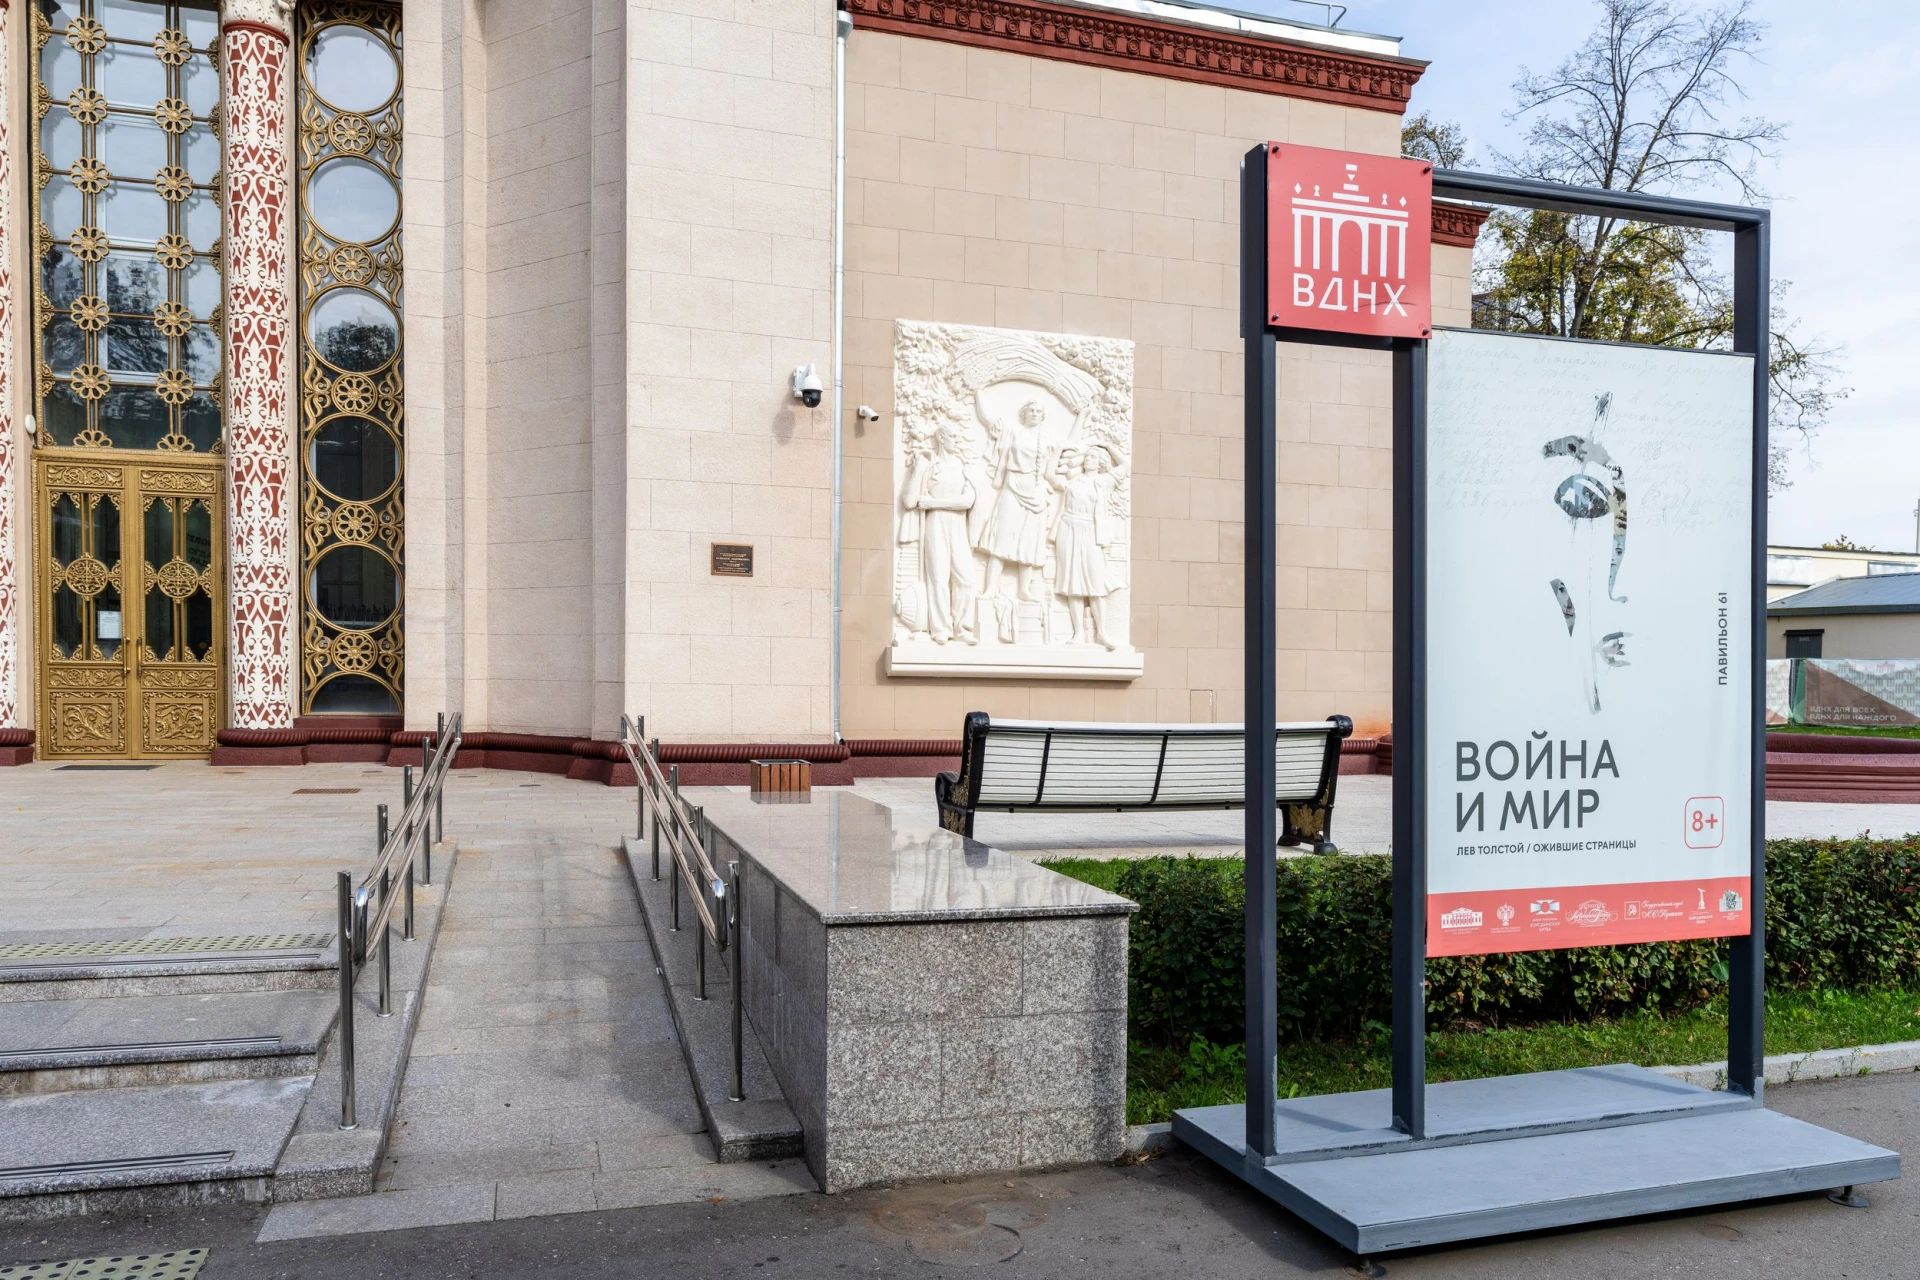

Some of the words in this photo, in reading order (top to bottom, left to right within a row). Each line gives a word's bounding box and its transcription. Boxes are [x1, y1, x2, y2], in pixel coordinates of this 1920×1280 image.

[1293, 272, 1408, 317] ВДНХ
[1718, 592, 1727, 604] 61
[1718, 608, 1728, 685] ПАВИЛЬОН
[1456, 730, 1620, 781] ВОЙНА
[1456, 791, 1484, 832] И
[1499, 788, 1600, 831] МИР
[1692, 810, 1718, 832] 8+
[1456, 846, 1476, 856] ЛЕВ
[1478, 842, 1524, 855] ТОЛСТОЙ
[1533, 841, 1584, 853] ОЖИВШИЕ
[1585, 839, 1637, 851] СТРАНИЦЫ
